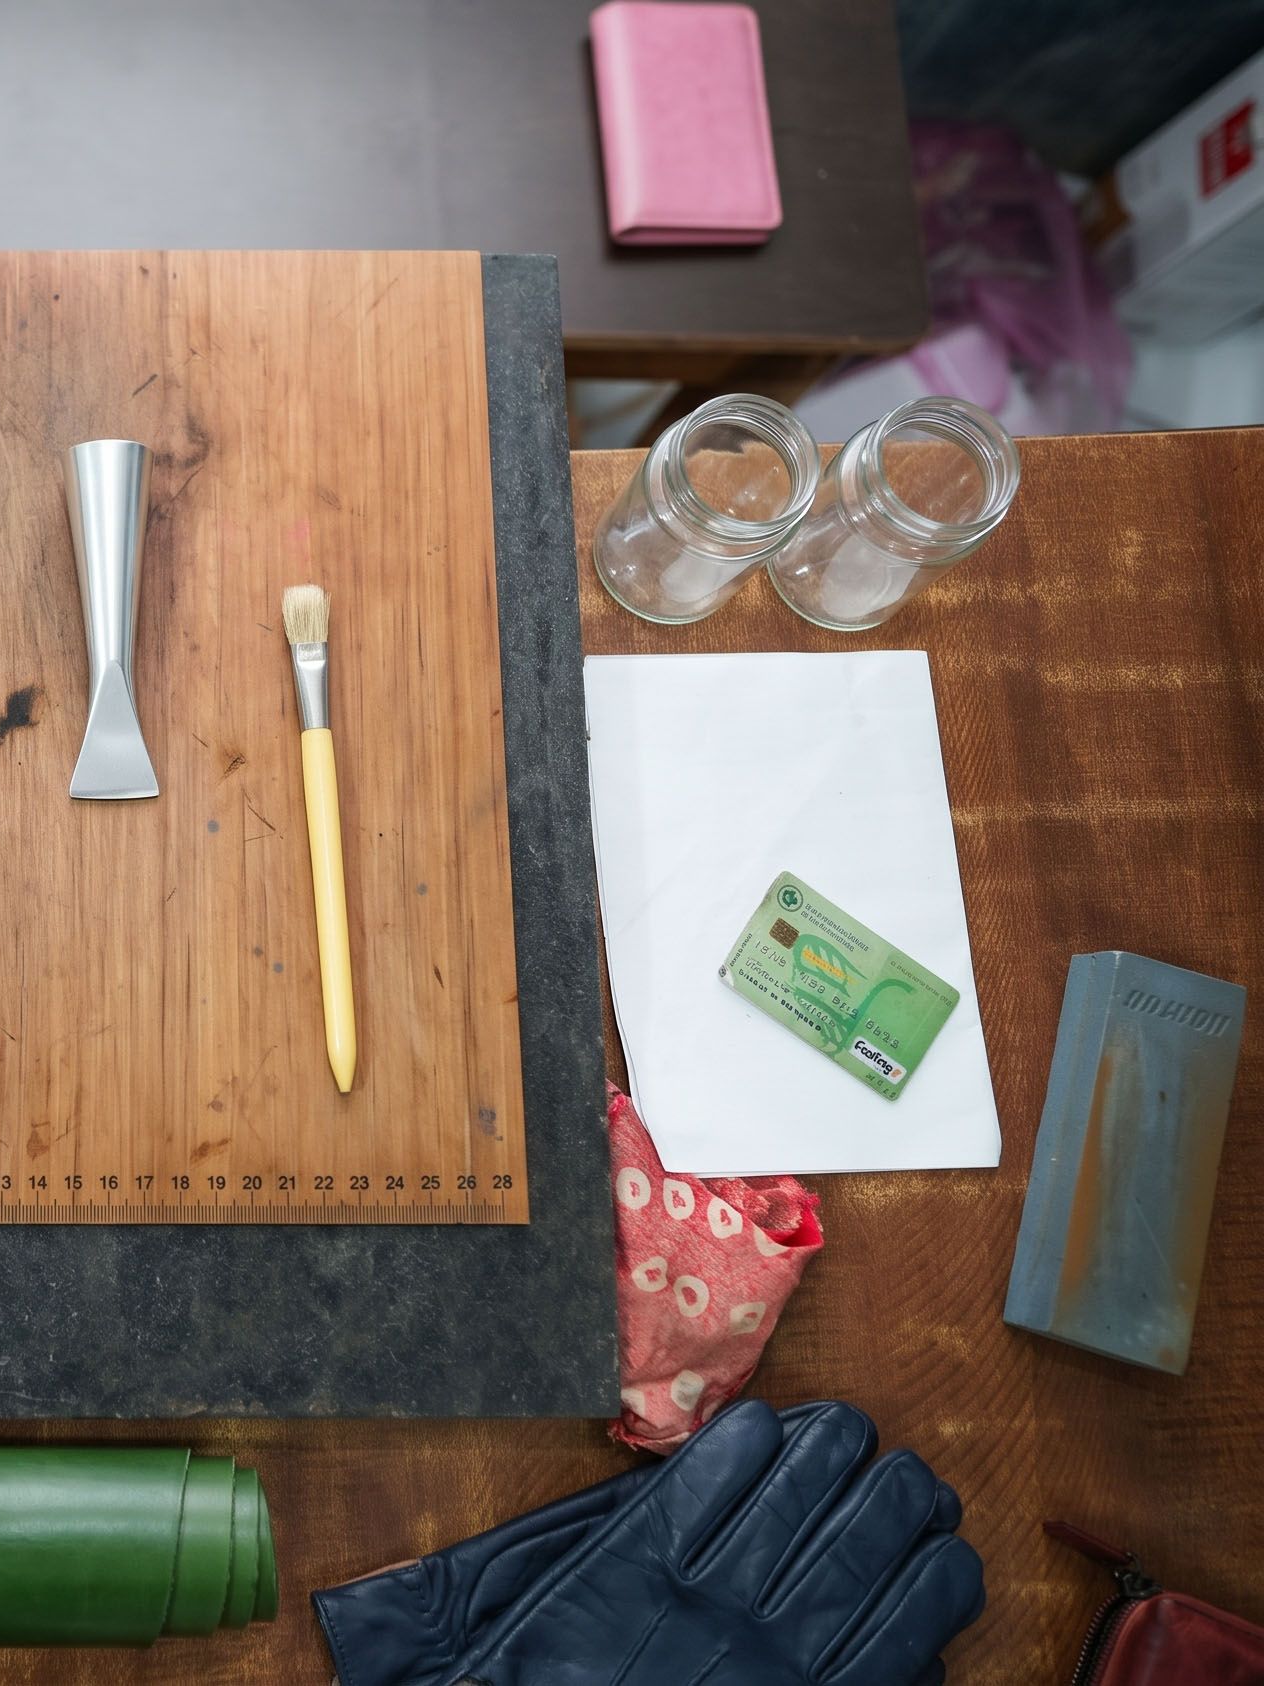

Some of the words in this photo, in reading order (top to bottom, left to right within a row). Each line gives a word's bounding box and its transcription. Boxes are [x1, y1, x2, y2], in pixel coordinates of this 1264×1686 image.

[28, 1175, 48, 1190] 14
[64, 1174, 83, 1190] 15
[99, 1175, 119, 1190] 16
[135, 1175, 155, 1190] 17
[171, 1175, 190, 1190] 18
[207, 1175, 226, 1190] 19
[242, 1175, 263, 1190] 20
[278, 1175, 296, 1190] 21
[314, 1175, 334, 1191] 22
[349, 1175, 370, 1191] 23
[385, 1175, 405, 1190] 24
[420, 1175, 441, 1190] 25
[456, 1174, 477, 1190] 26
[492, 1174, 513, 1190] 28
